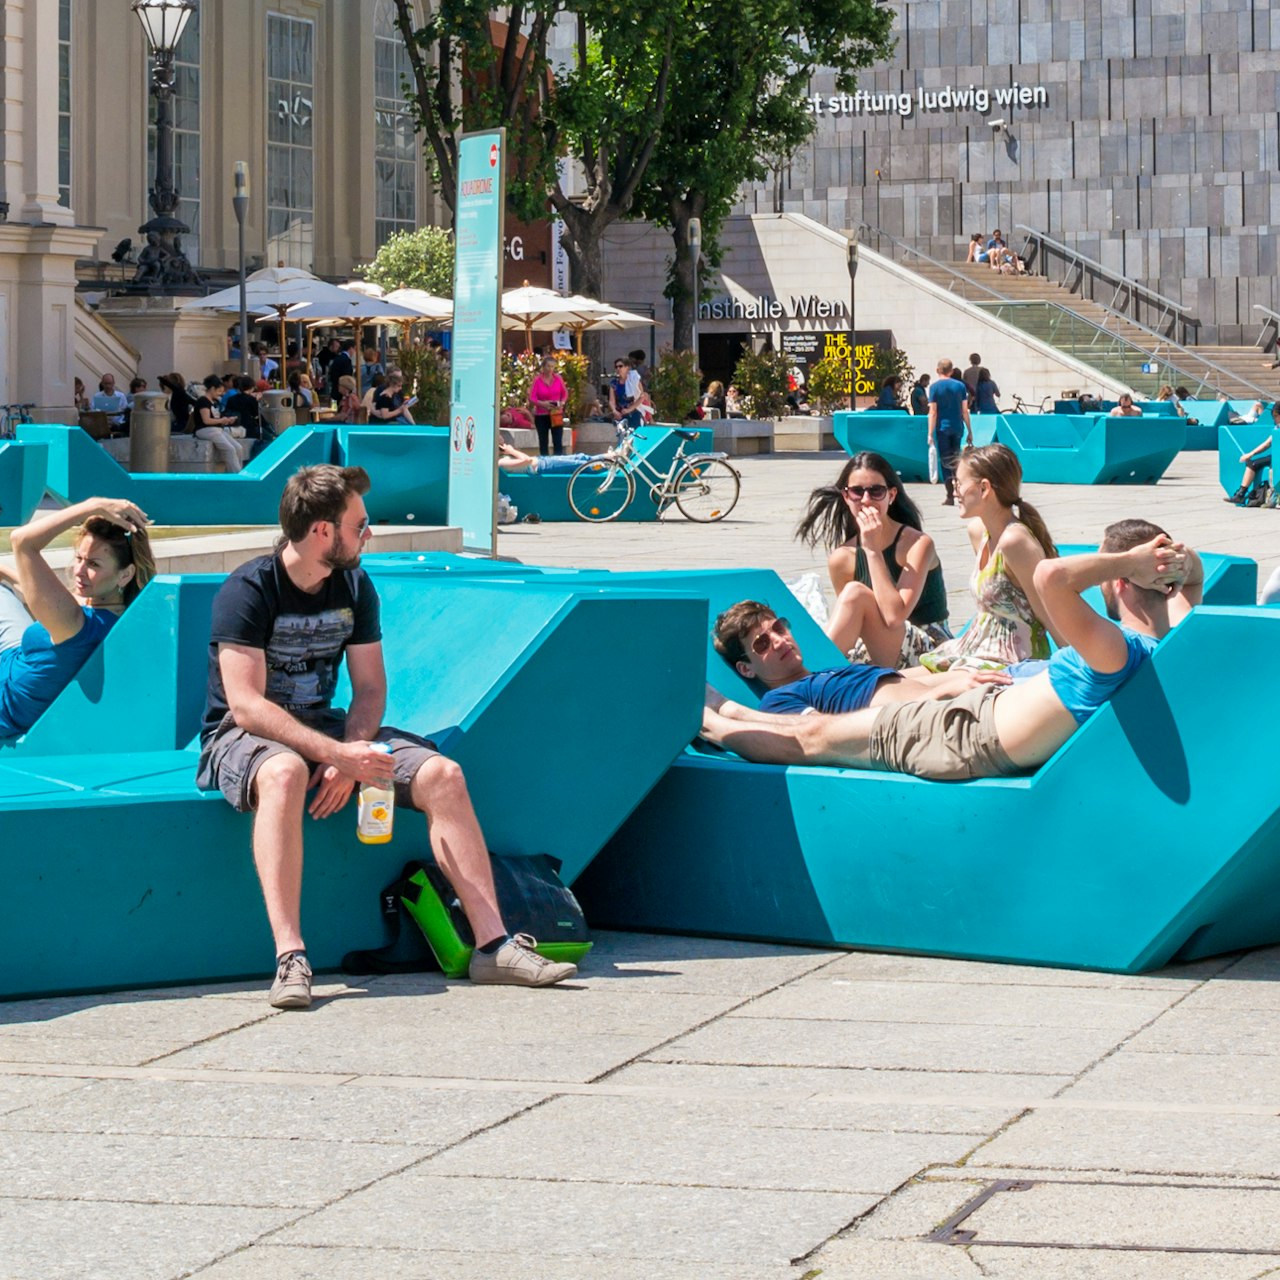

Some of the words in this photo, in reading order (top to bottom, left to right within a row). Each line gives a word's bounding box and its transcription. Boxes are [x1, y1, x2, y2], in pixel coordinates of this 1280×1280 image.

[829, 89, 911, 116] stiftung
[919, 85, 990, 111] ludwig
[995, 82, 1047, 105] wien
[789, 295, 844, 318] Wien
[825, 333, 847, 346] THE
